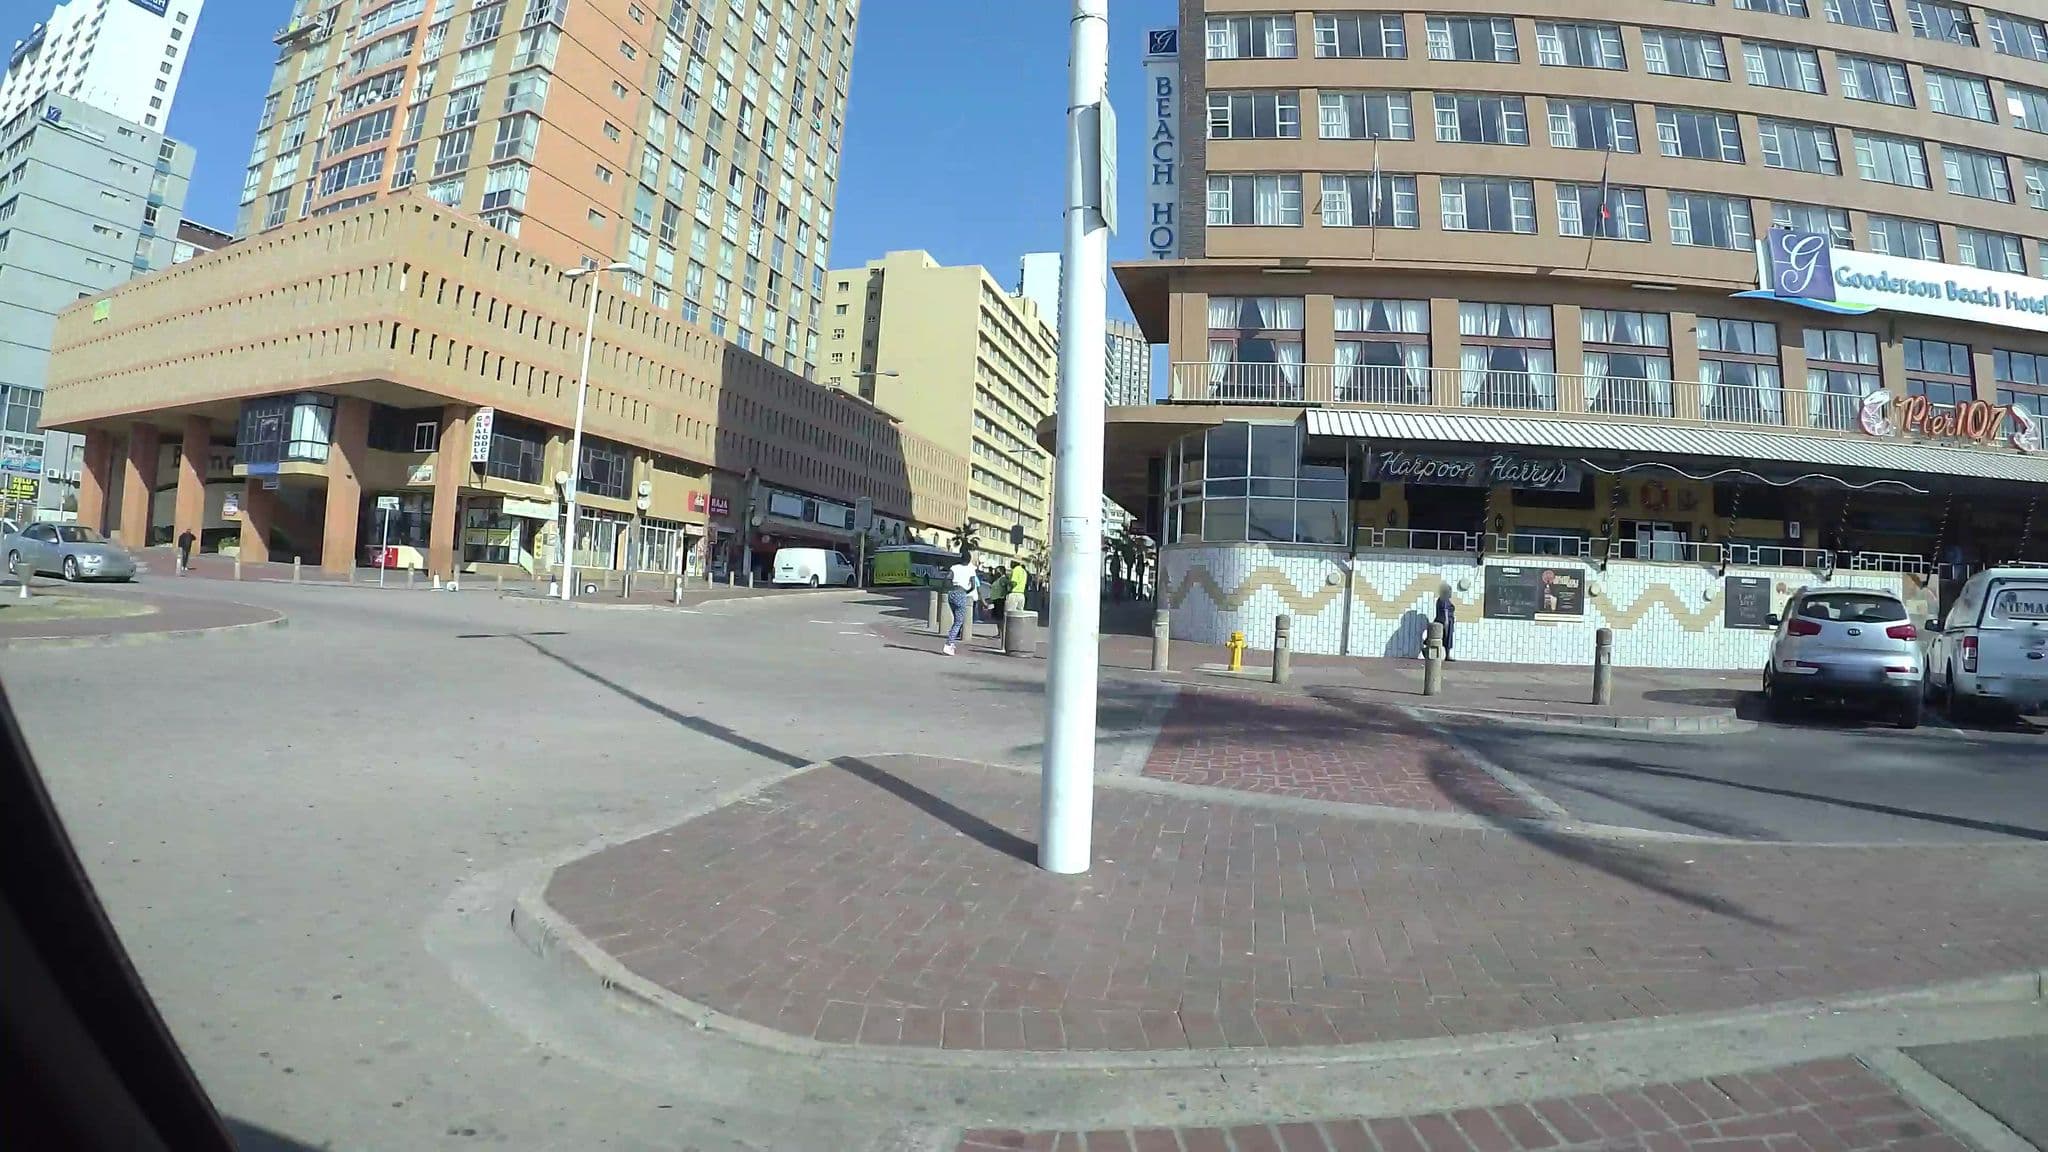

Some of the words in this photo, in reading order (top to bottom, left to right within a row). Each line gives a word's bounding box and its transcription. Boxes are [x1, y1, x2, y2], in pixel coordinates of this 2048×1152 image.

[1152, 76, 1175, 185] BEACH
[1834, 265, 1942, 300] Gooderson
[1944, 279, 2000, 308] Beach
[2004, 290, 2048, 316] Hotel
[472, 415, 482, 460] GRANDLA
[480, 428, 489, 460] LODGE
[1380, 449, 1476, 482] Harpoon
